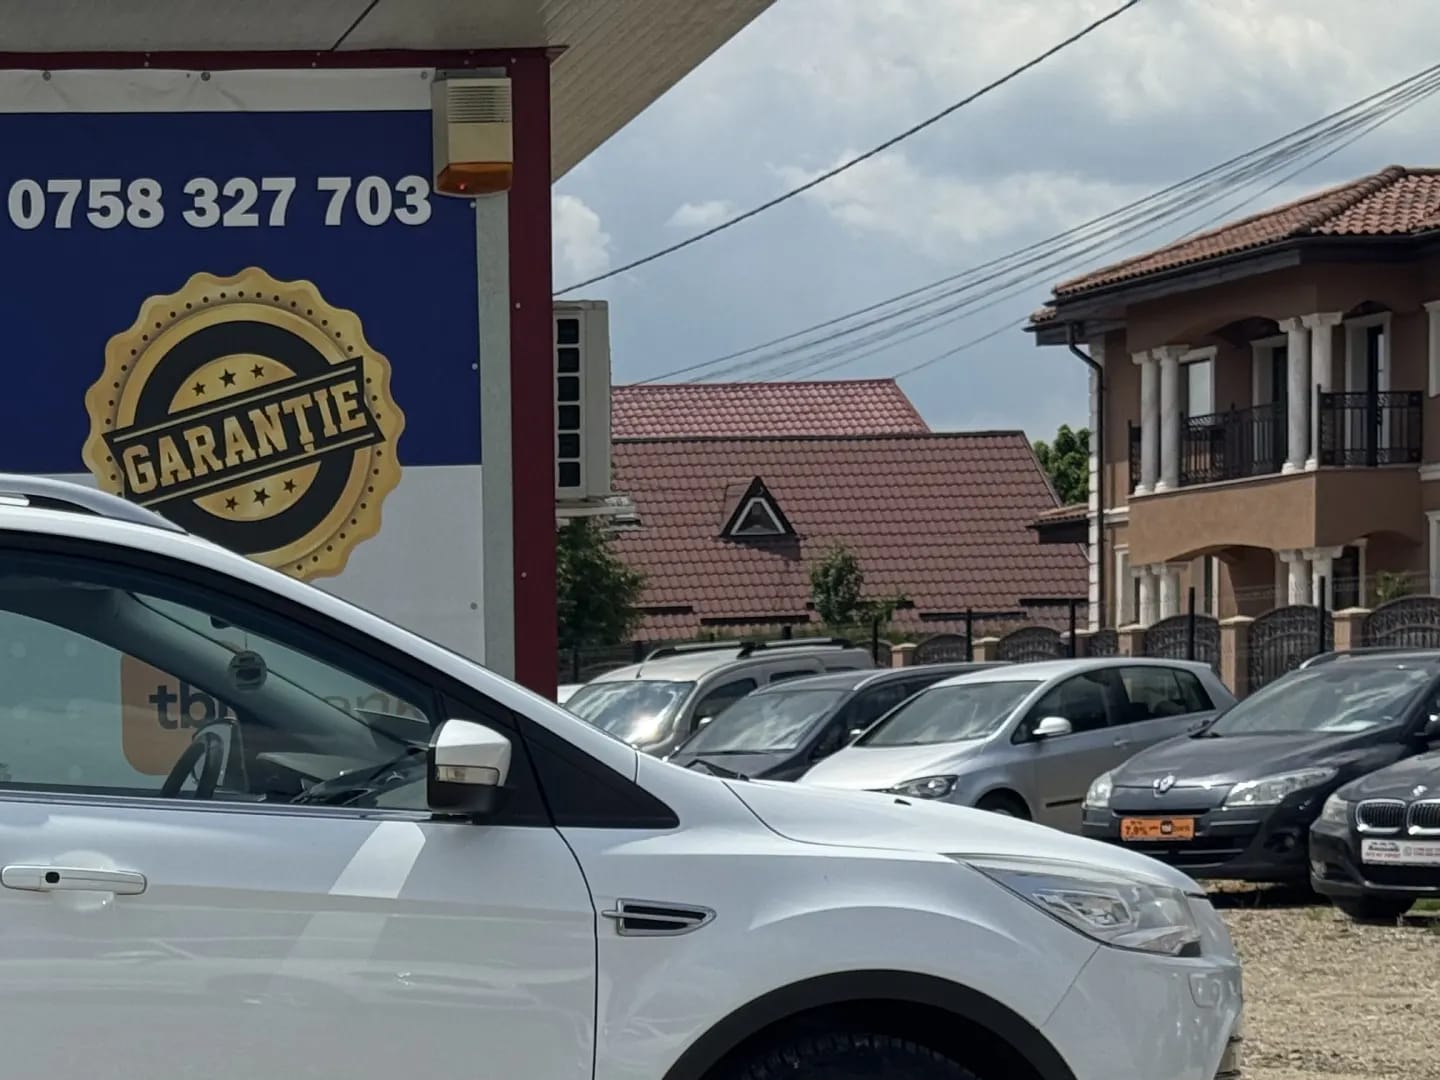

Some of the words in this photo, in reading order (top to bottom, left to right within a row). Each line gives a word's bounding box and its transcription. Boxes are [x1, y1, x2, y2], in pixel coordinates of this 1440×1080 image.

[8, 178, 164, 229] 0758
[182, 177, 297, 228] 327
[317, 175, 432, 226] 703
